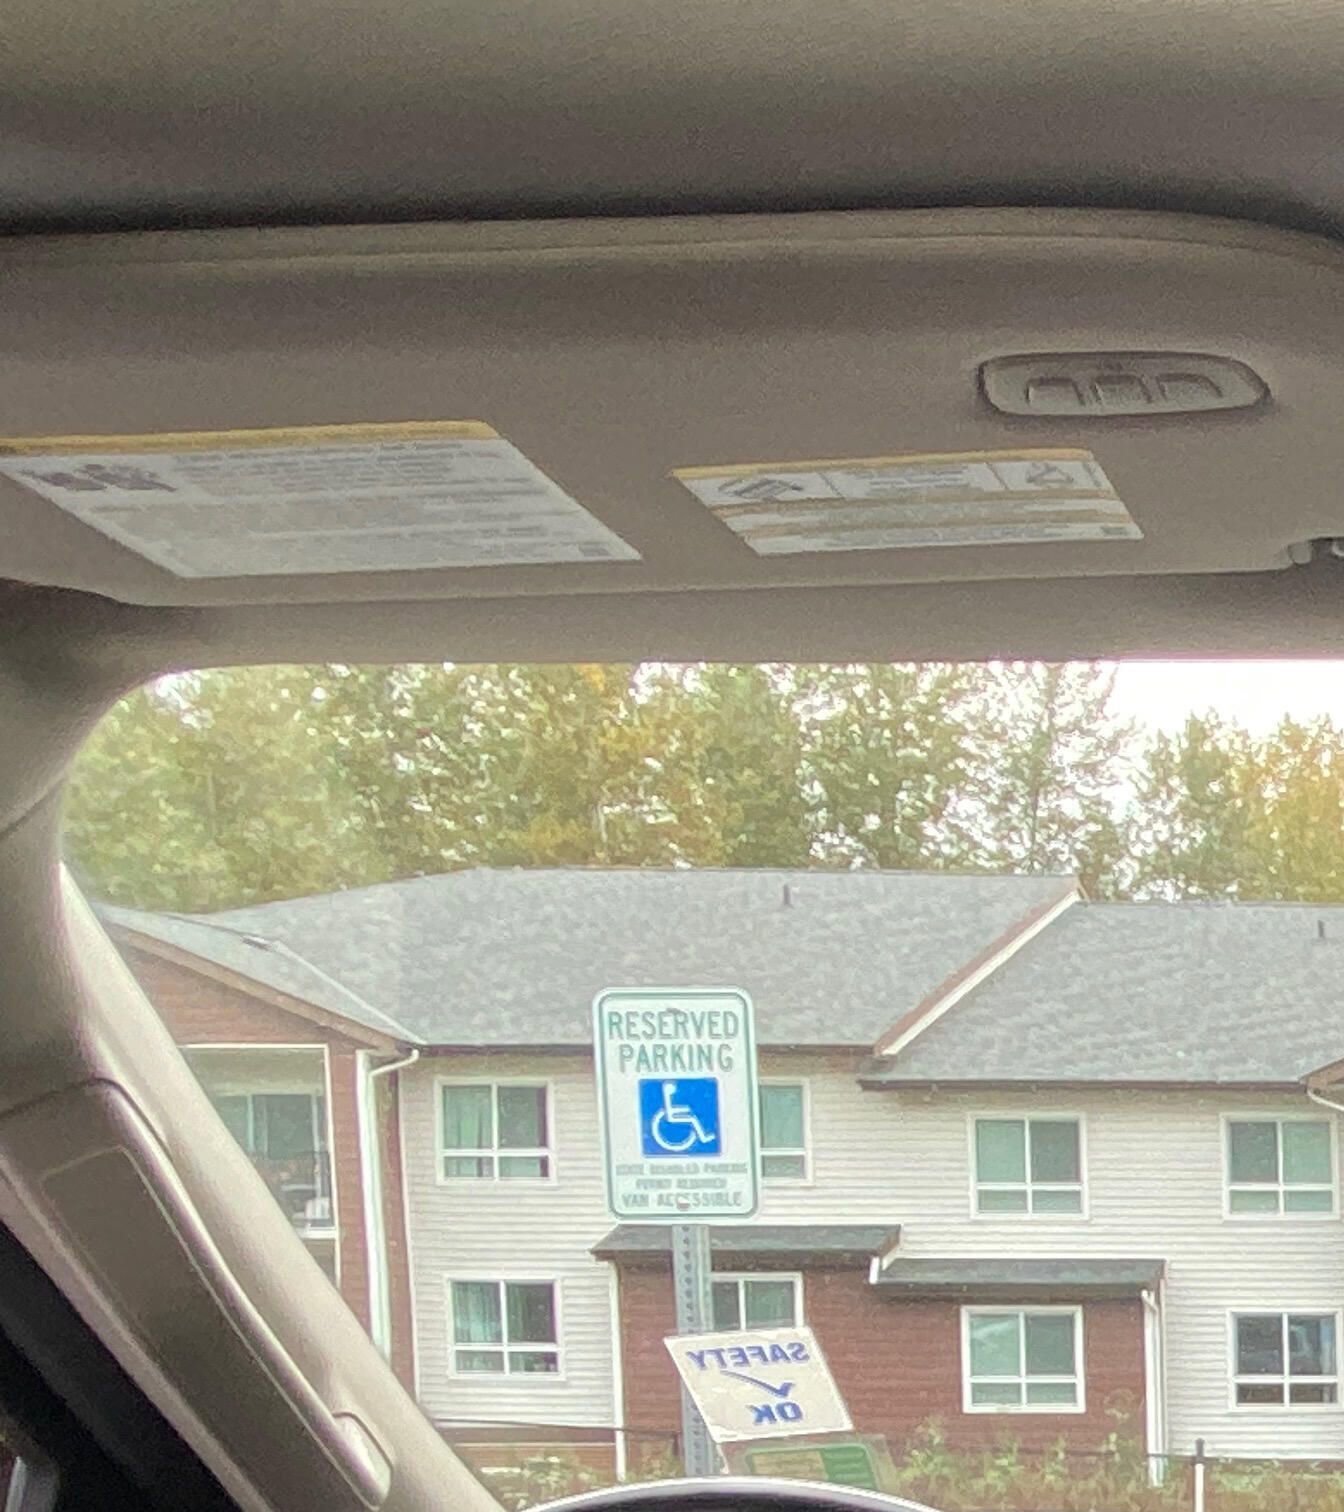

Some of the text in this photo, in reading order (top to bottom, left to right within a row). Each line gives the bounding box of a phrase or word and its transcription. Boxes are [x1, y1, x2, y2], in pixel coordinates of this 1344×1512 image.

[607, 1010, 739, 1040] RESERVED
[619, 1043, 733, 1073] PARKING
[621, 1193, 649, 1207] VAN
